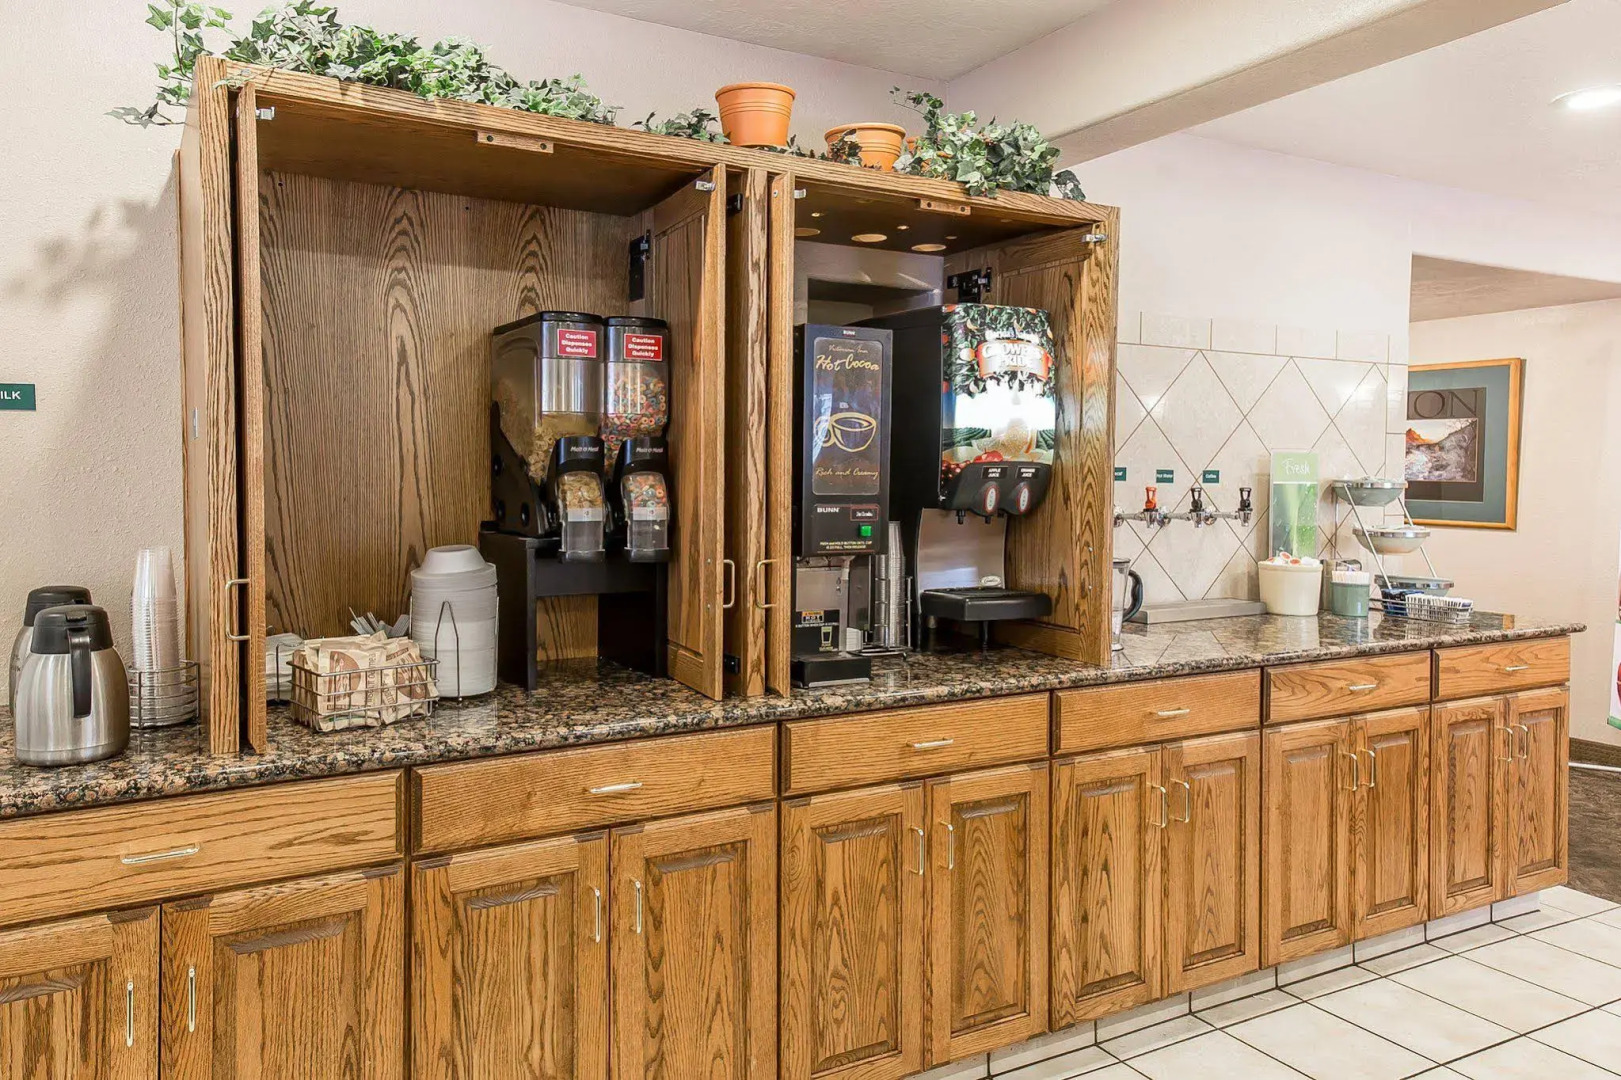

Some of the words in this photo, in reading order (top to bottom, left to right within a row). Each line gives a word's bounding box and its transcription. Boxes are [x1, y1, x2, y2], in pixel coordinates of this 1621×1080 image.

[561, 339, 593, 347] Dispenses
[628, 343, 659, 351] Dispenses
[565, 346, 588, 354] Quickly
[816, 354, 846, 371] Hot
[845, 353, 880, 371] Cocoa
[0, 390, 21, 400] ILK
[1413, 390, 1483, 418] ON
[834, 468, 851, 476] and
[852, 467, 879, 480] Creamy
